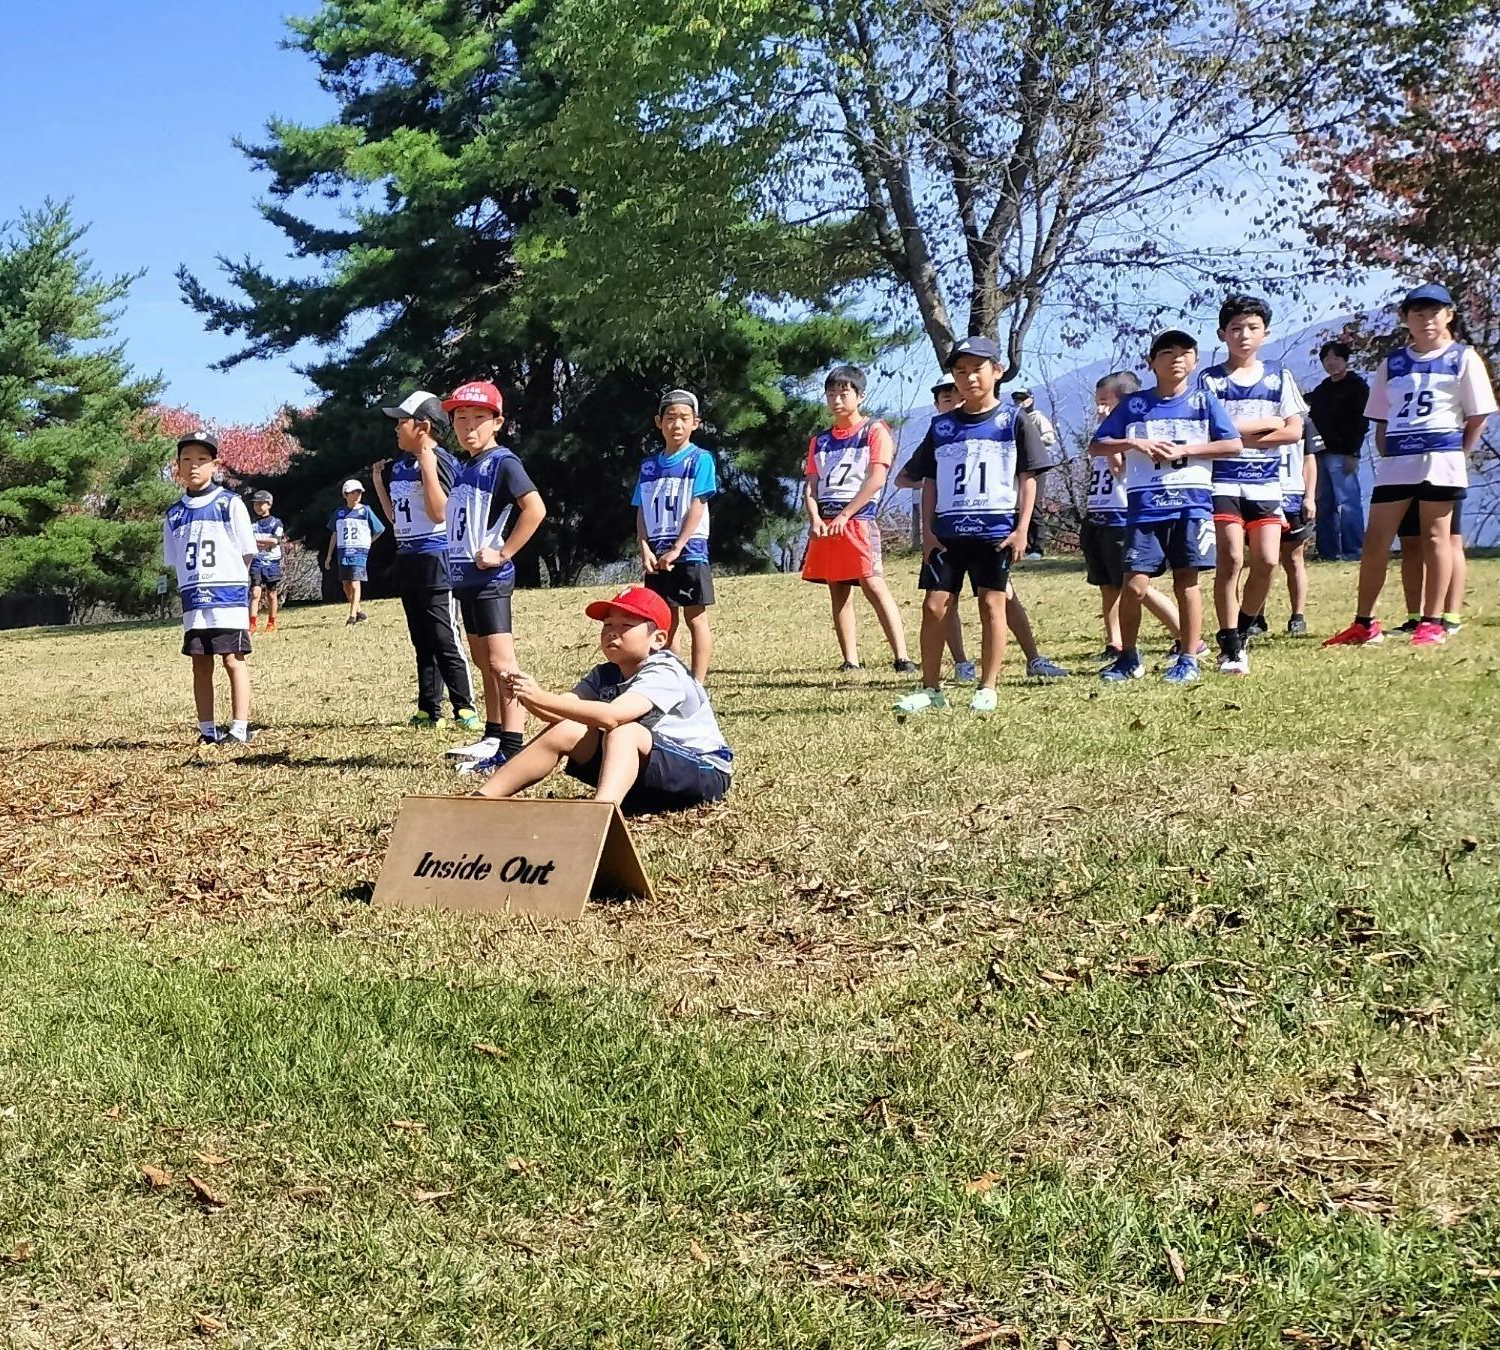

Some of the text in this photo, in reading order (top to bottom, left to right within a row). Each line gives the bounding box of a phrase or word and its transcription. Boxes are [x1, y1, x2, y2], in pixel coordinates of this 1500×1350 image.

[1396, 390, 1434, 418] 25
[953, 461, 987, 496] 21
[1088, 468, 1114, 496] 23
[1237, 470, 1263, 479] NORD
[653, 495, 679, 524] 14
[343, 527, 358, 540] 22
[954, 525, 984, 533] NORD
[185, 539, 216, 571] 33
[413, 851, 556, 885] Inside Out
